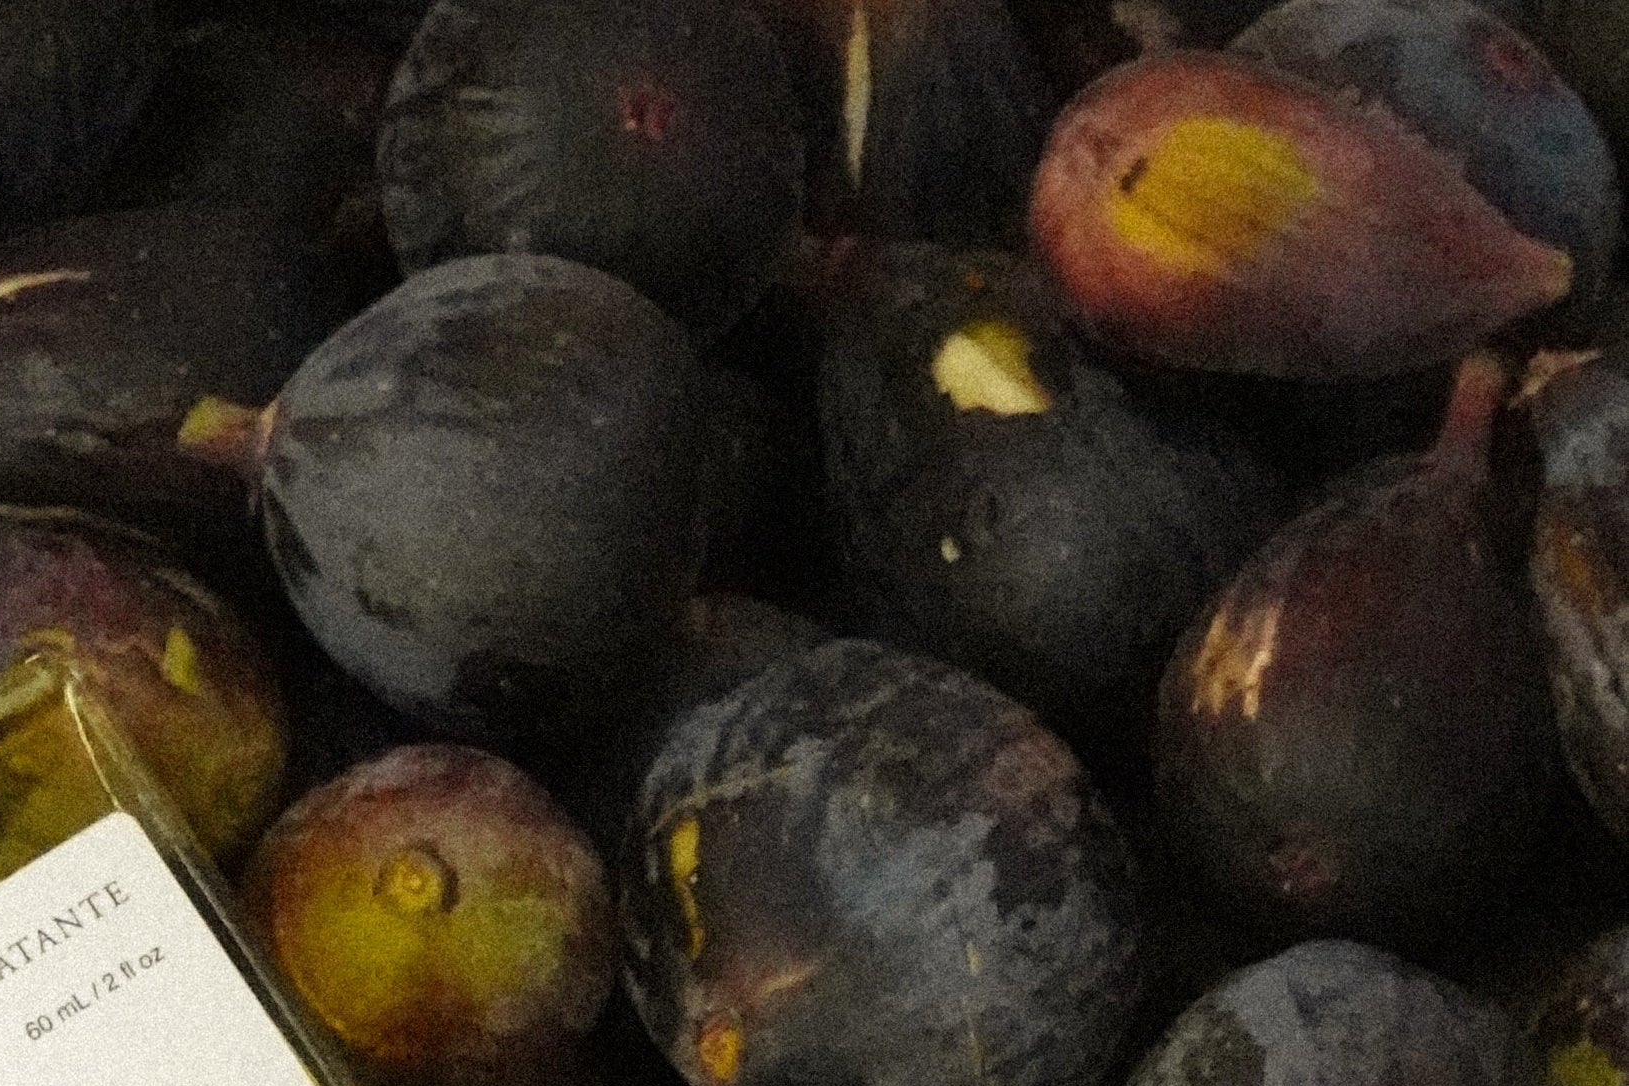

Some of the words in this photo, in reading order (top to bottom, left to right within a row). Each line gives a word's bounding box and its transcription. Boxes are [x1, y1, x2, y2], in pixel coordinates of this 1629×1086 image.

[26, 1015, 53, 1039] 60
[58, 994, 91, 1022] mL
[103, 973, 120, 992] 2
[140, 947, 165, 969] oz
